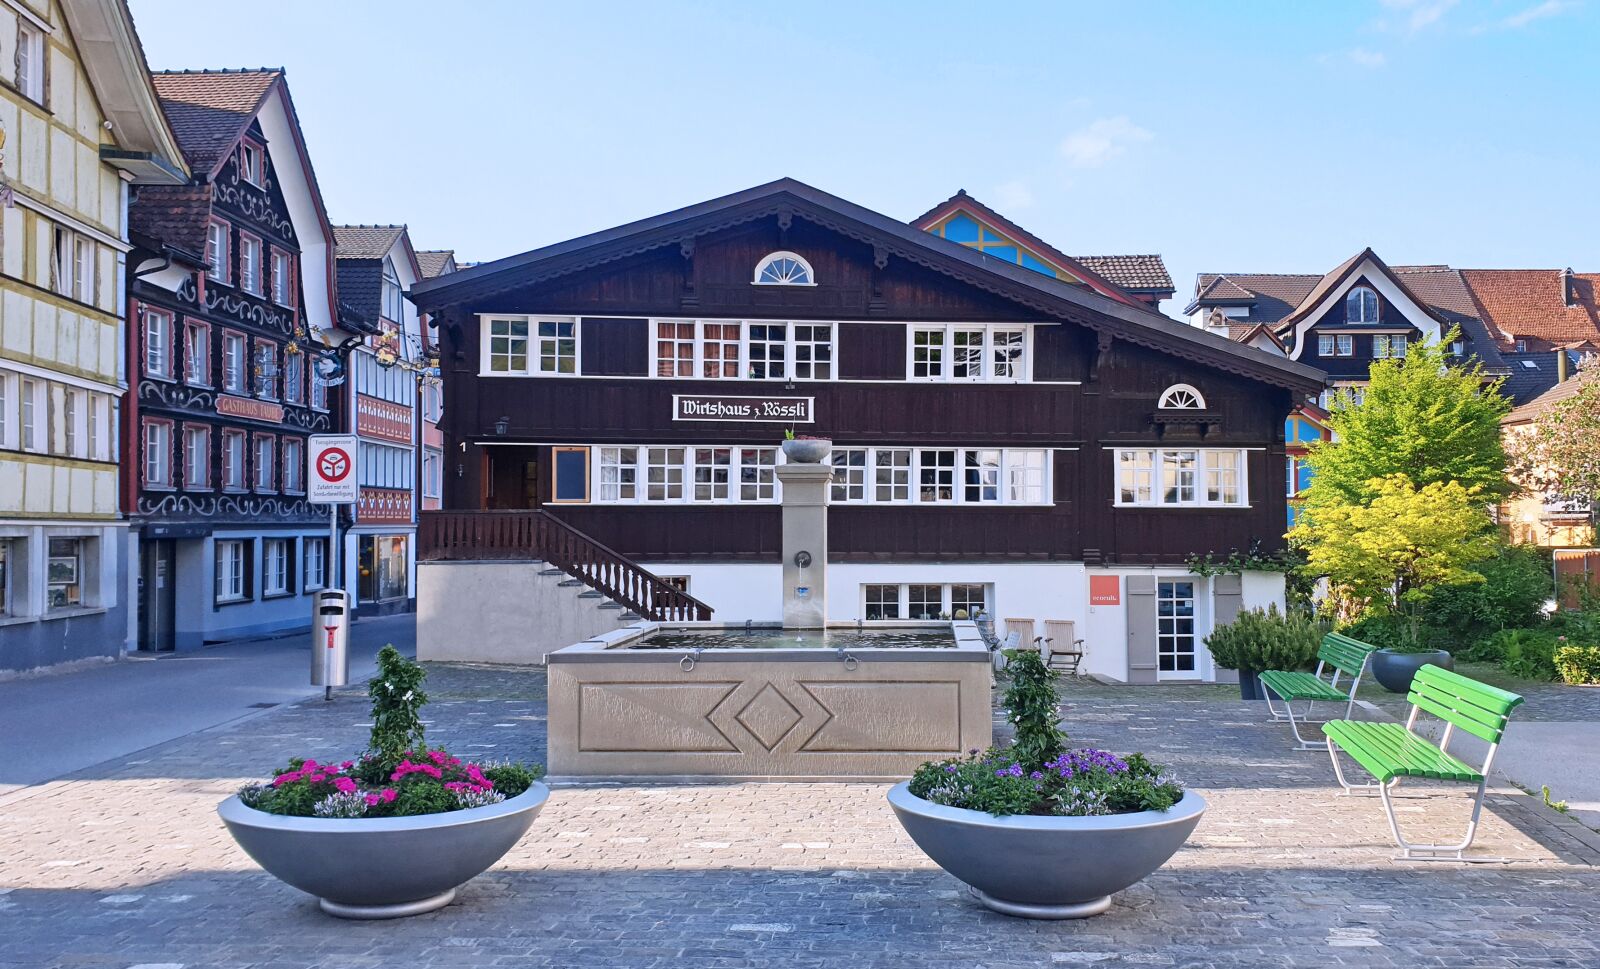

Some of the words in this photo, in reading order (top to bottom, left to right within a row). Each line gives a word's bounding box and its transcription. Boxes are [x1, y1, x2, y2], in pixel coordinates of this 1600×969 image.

[222, 398, 258, 415] GASTHAUS
[682, 400, 751, 418] Wirtshaus
[762, 402, 805, 417] Rössli
[459, 441, 466, 453] 1
